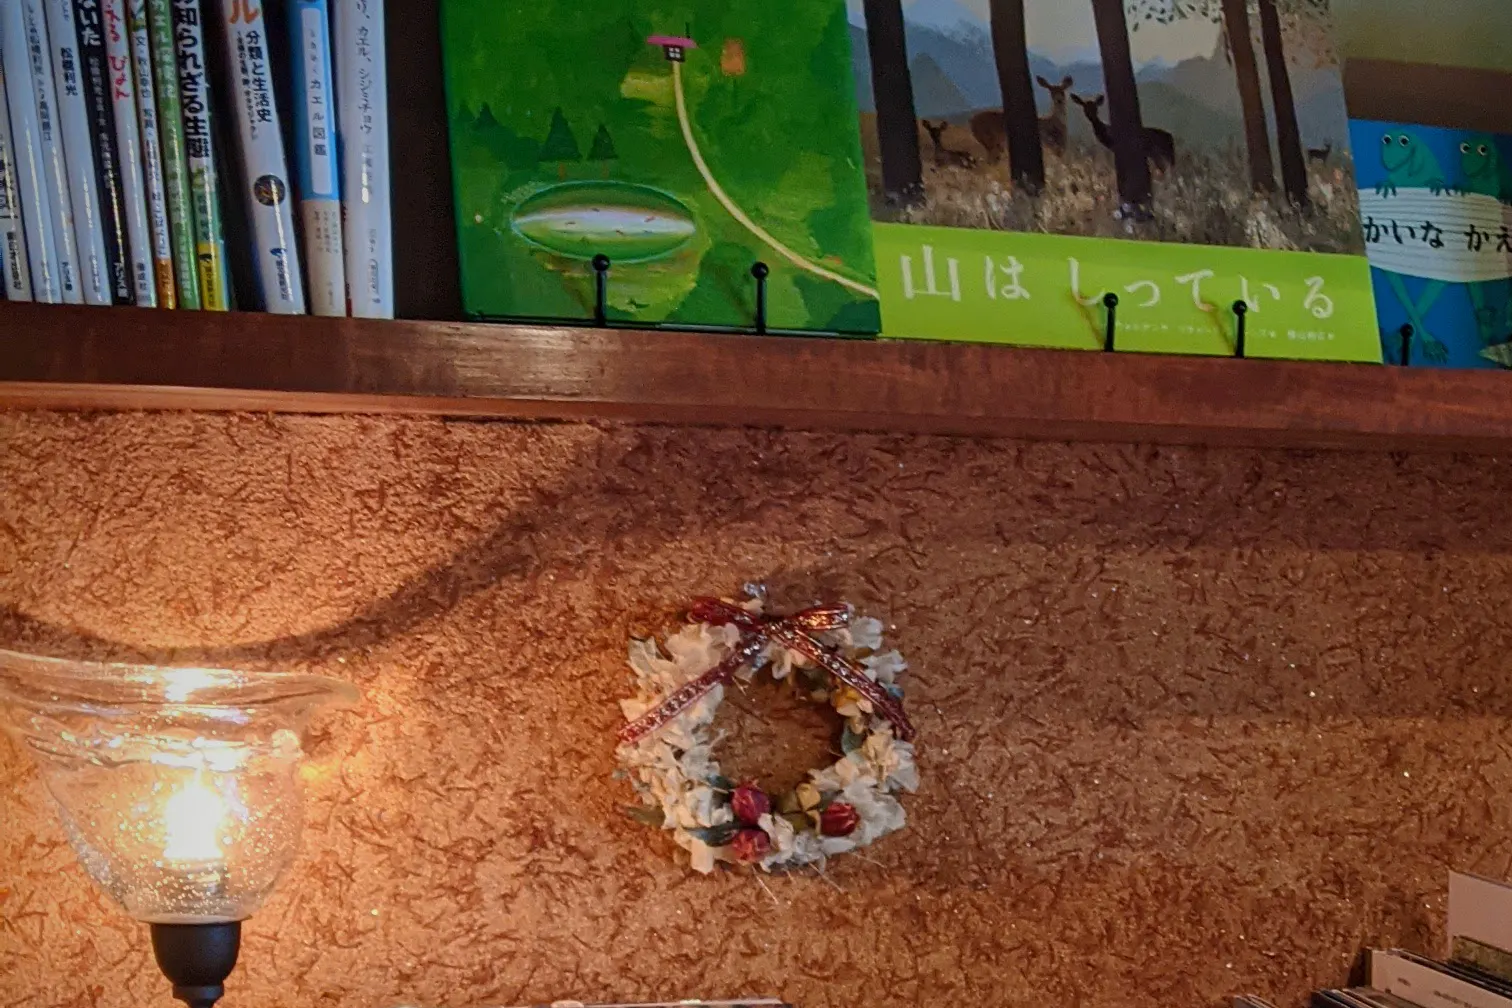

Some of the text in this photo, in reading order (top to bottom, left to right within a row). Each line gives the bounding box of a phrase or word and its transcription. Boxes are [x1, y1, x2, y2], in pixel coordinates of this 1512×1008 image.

[1363, 216, 1445, 249] かいな
[900, 244, 1336, 320] 山はしっている
